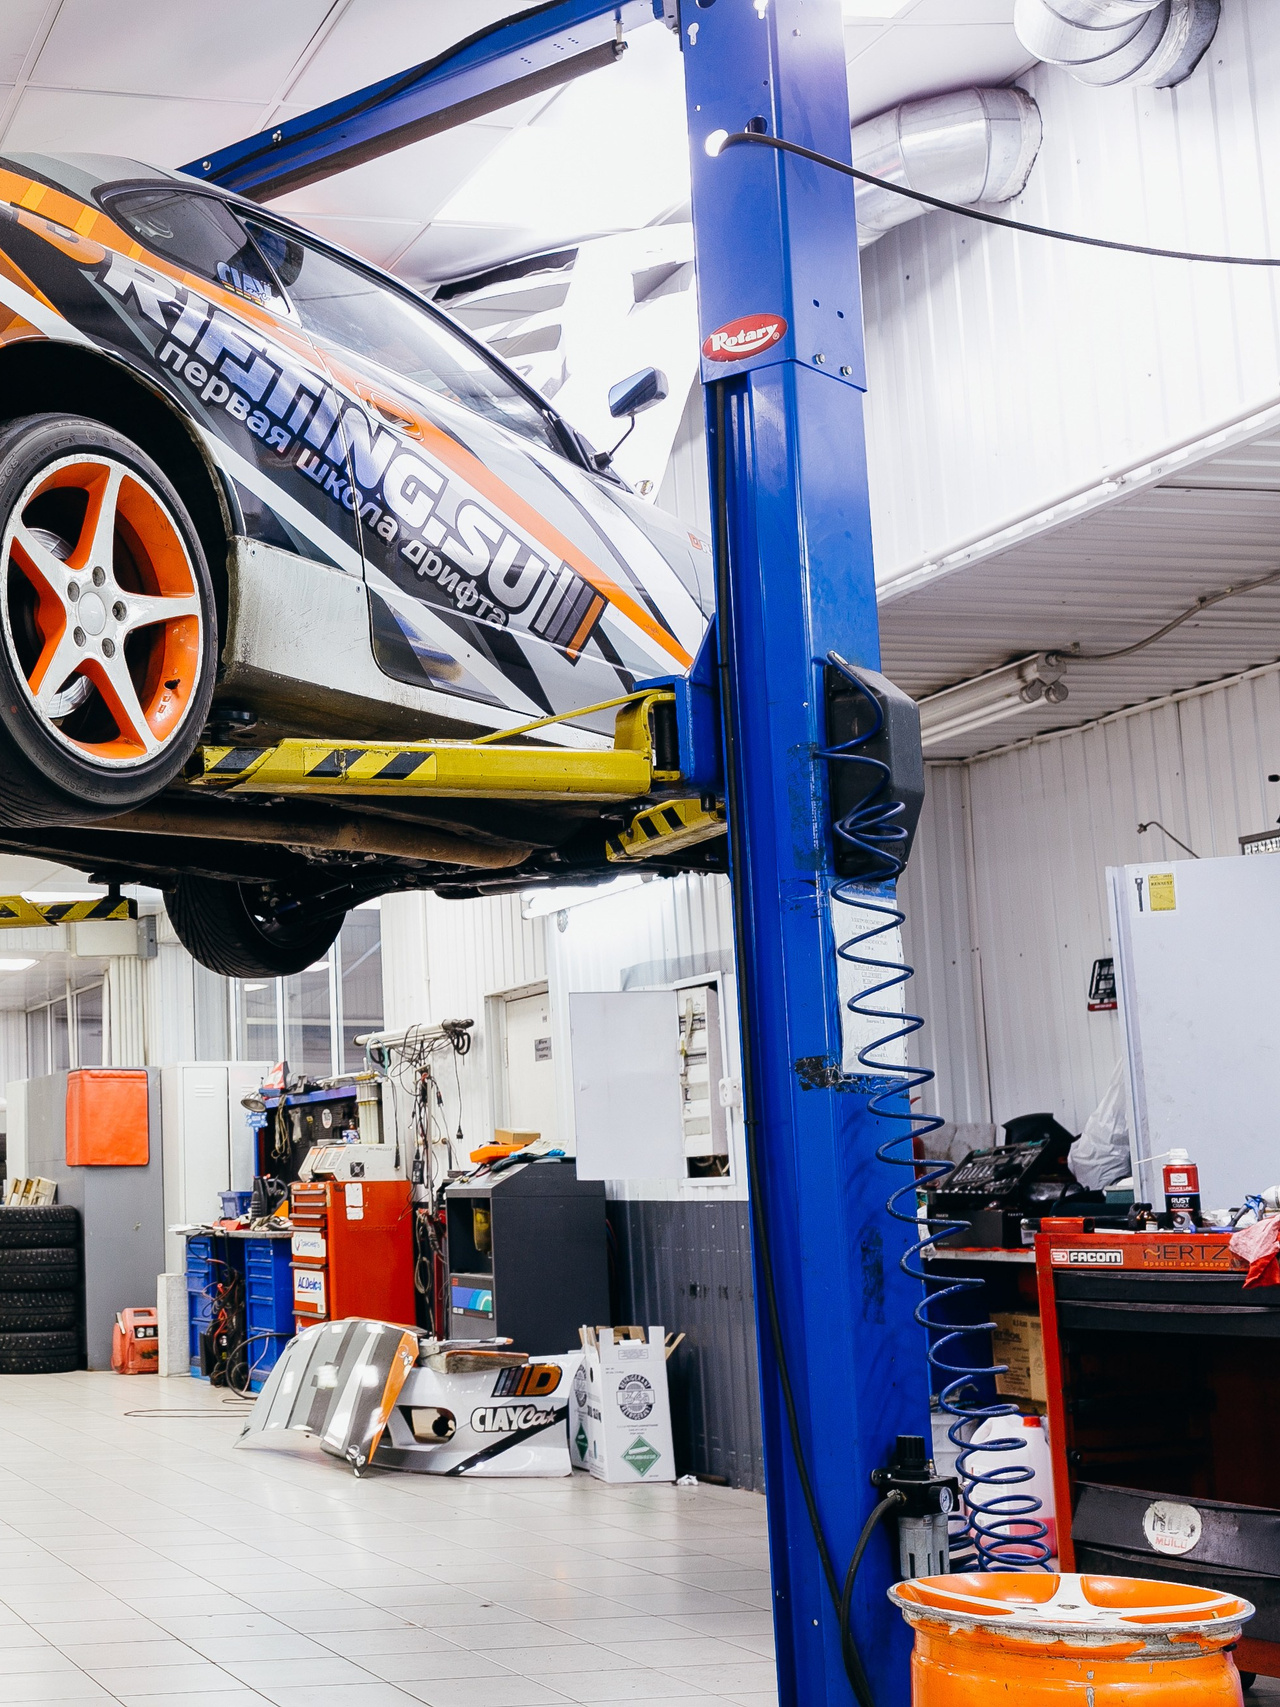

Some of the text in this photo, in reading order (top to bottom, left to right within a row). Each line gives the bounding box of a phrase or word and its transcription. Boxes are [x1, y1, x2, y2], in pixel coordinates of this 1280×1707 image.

[710, 323, 778, 352] Rotary
[159, 341, 291, 453] первая
[296, 449, 398, 543] школа
[401, 539, 509, 629] дрифта
[1070, 1252, 1121, 1263] FACOM
[1143, 1244, 1229, 1260] HERTZ
